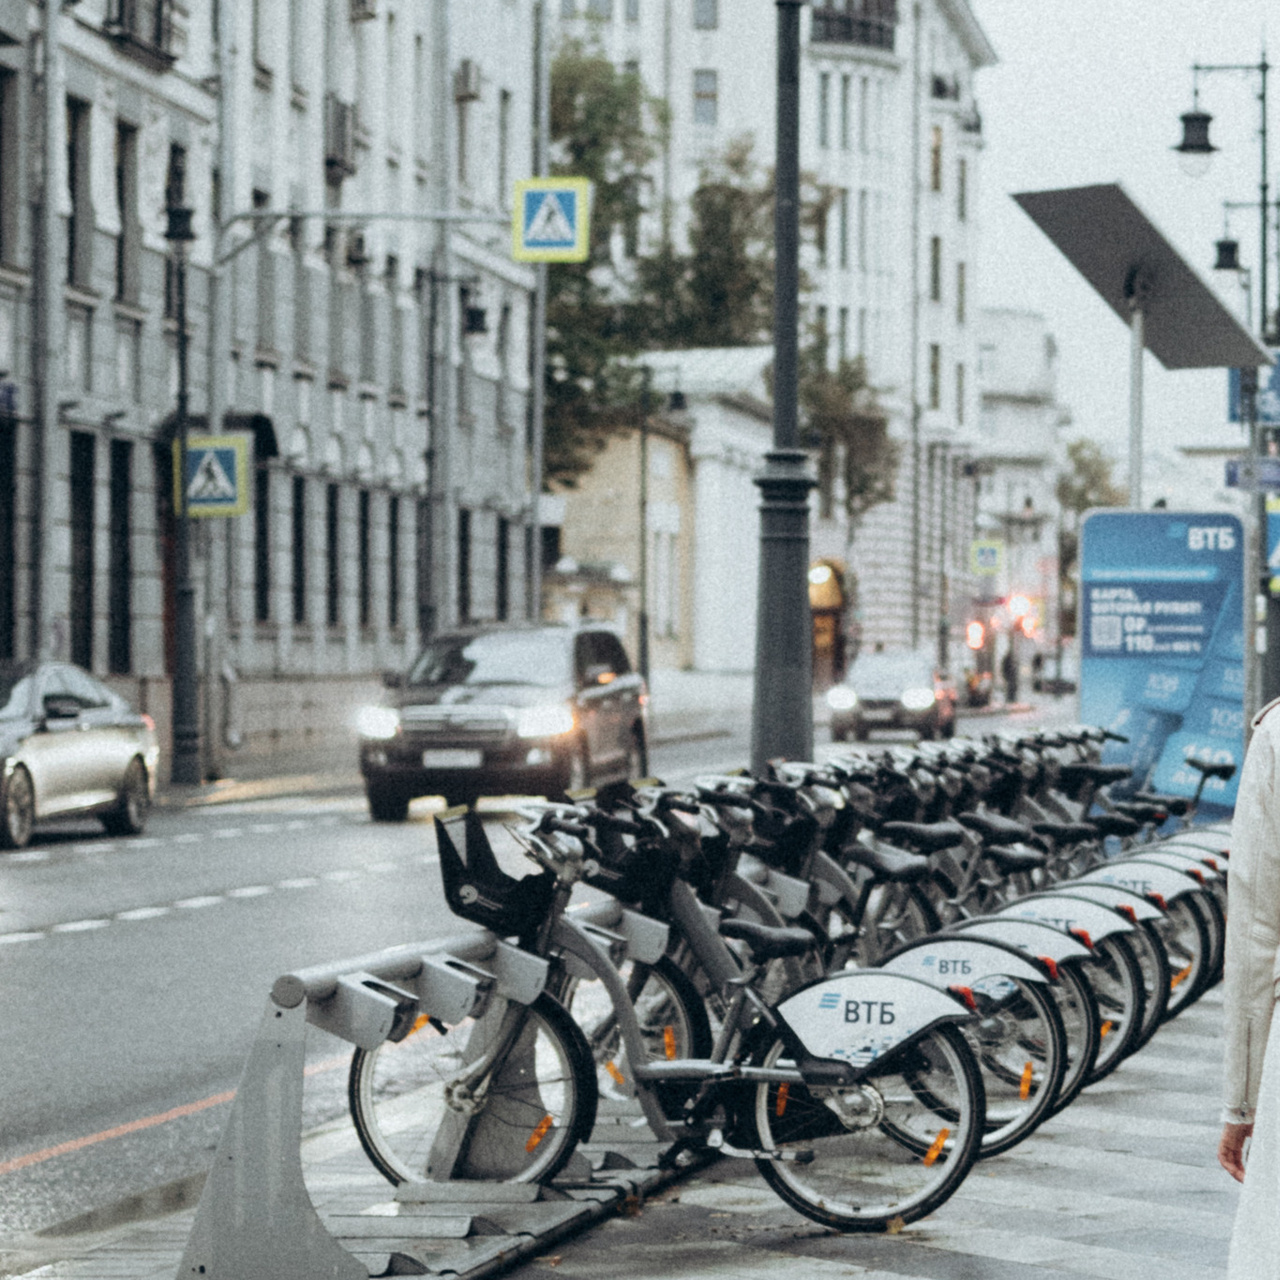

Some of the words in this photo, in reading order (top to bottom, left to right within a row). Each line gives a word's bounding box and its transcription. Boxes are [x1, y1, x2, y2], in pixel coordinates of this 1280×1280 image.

[1188, 526, 1236, 551] ВТБ
[938, 959, 972, 974] ВТБ
[844, 1000, 895, 1025] ВТБ
